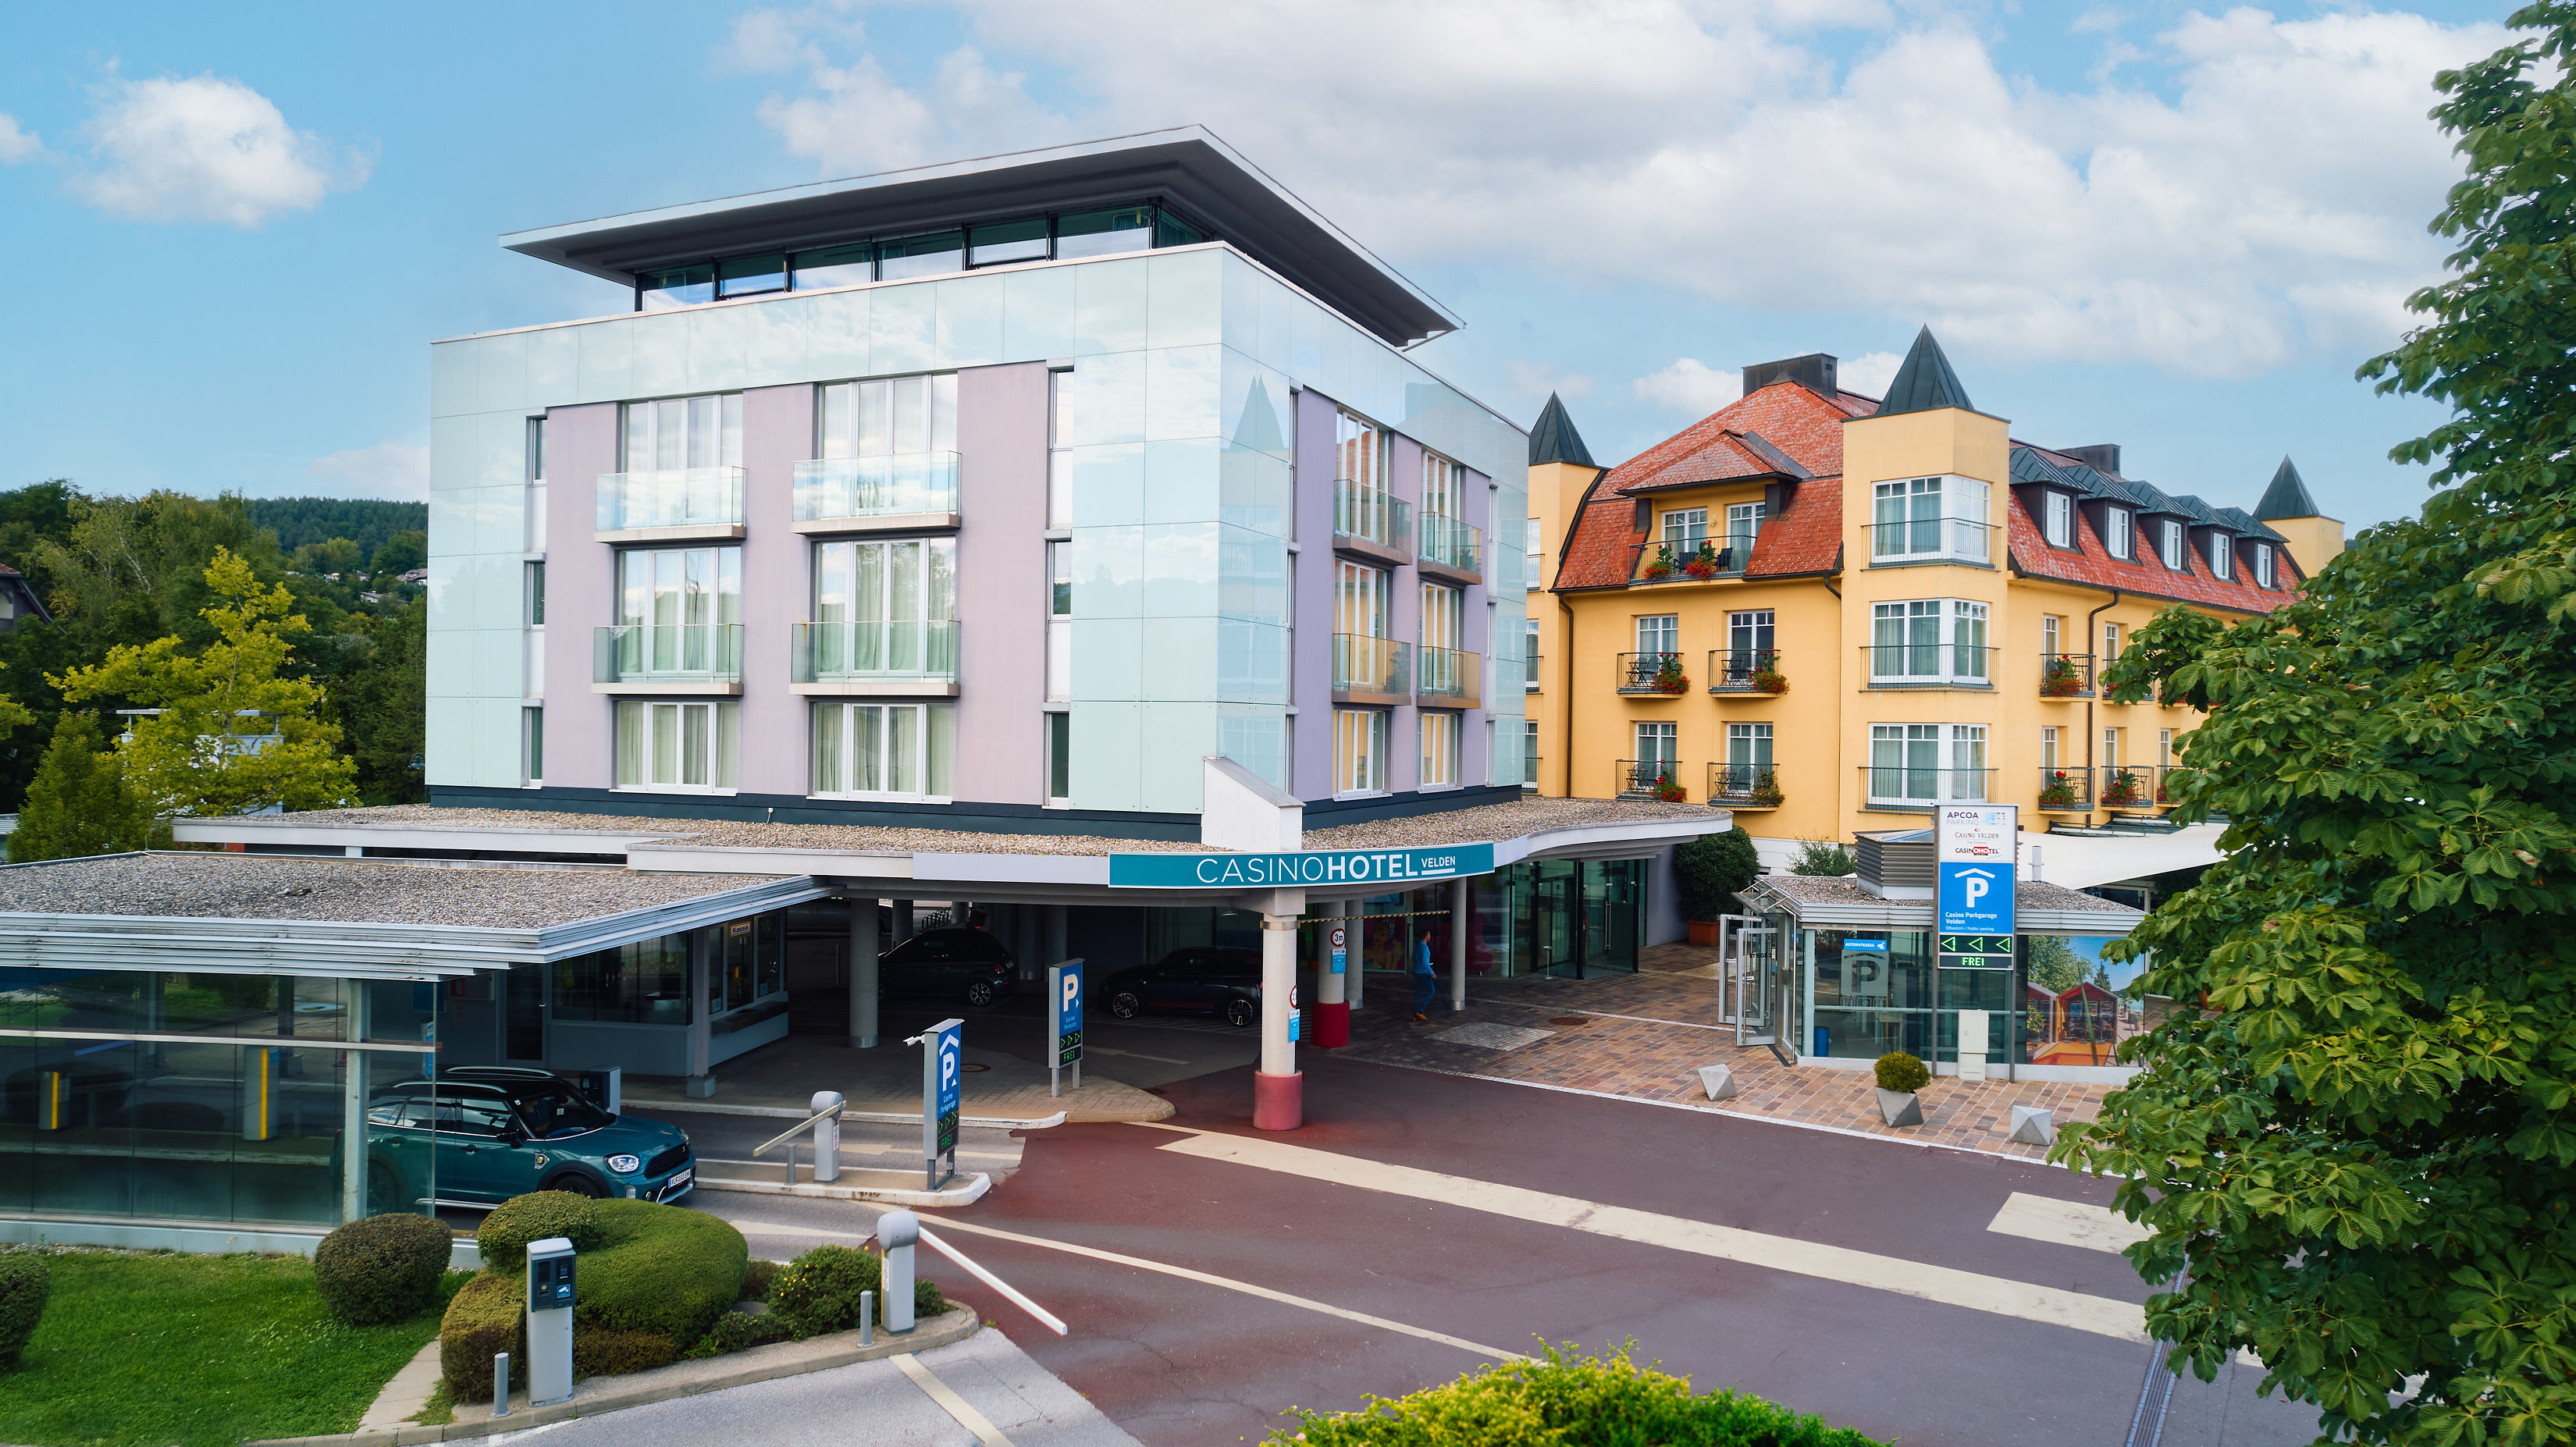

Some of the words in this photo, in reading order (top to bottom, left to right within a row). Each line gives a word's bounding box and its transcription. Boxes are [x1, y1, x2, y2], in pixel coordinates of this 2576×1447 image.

[1197, 853, 1418, 883] CASINOHOTEL
[1421, 855, 1456, 868] VELDEN
[1967, 877, 1989, 908] P
[1962, 957, 1985, 966] FREI
[1064, 973, 1078, 1012] P
[1063, 1051, 1075, 1062] FREI
[943, 1052, 955, 1092] P
[940, 1100, 956, 1113] Parkgarage
[944, 1093, 953, 1103] Casino
